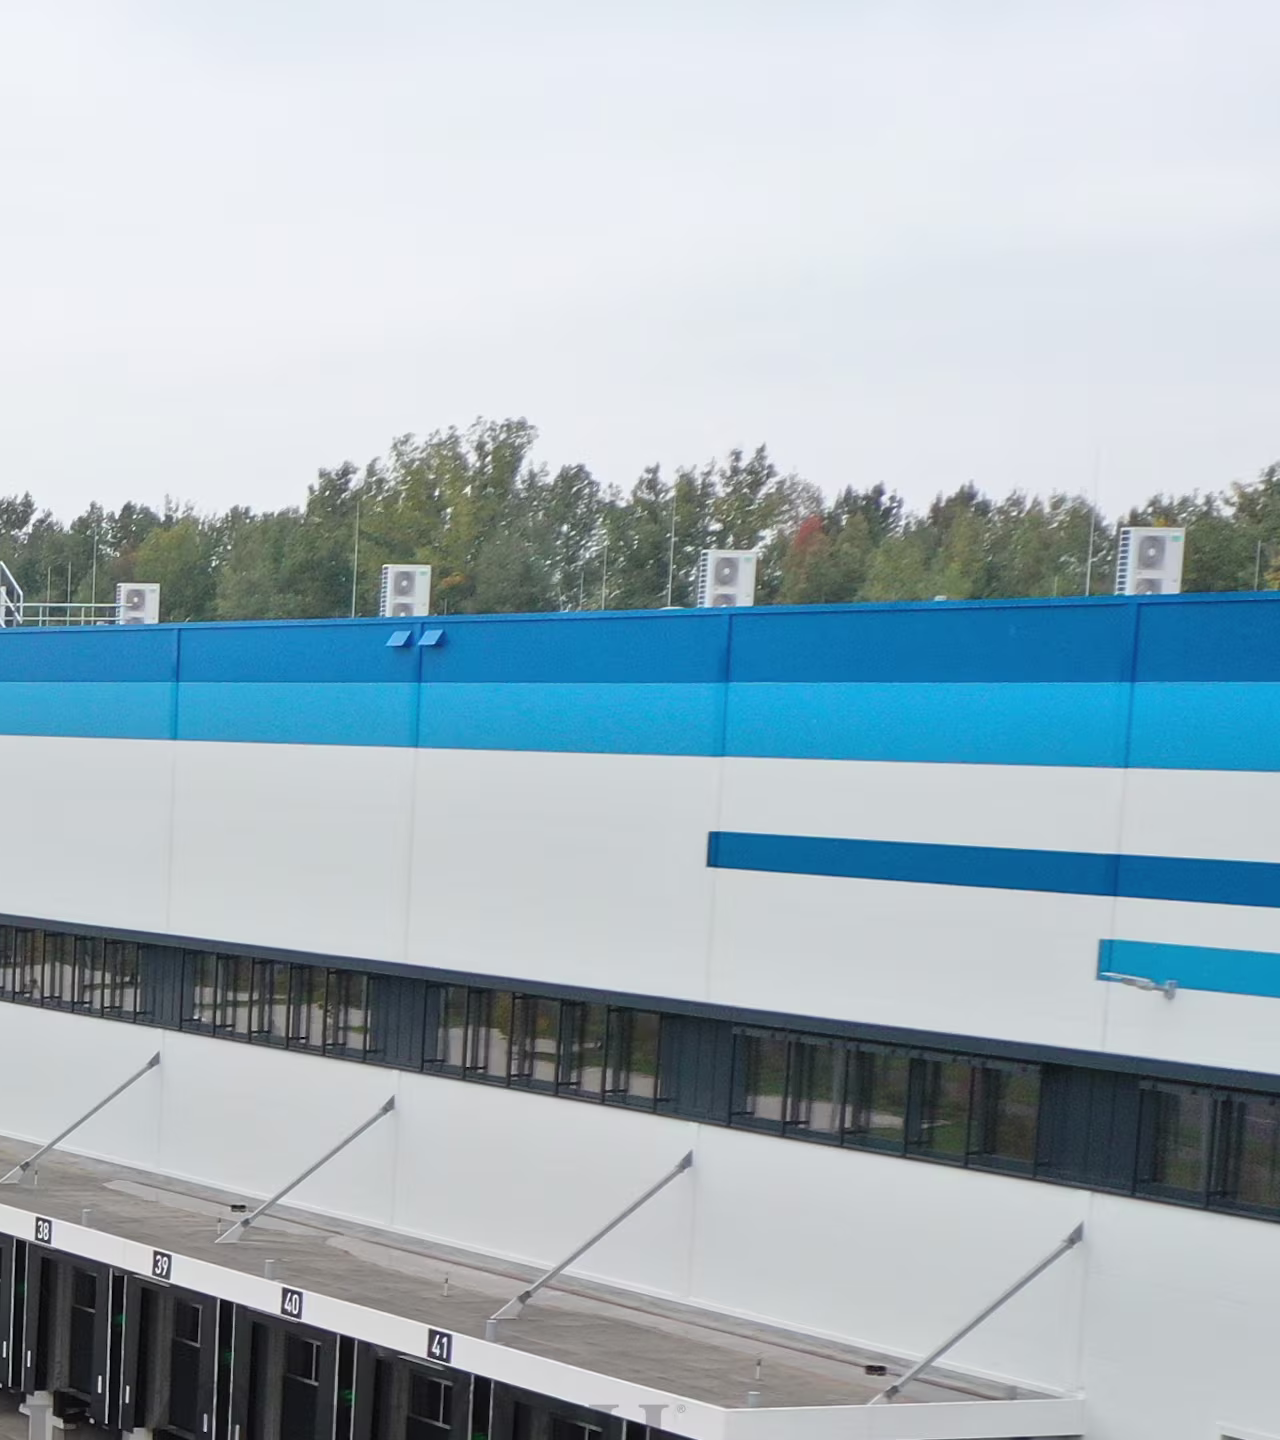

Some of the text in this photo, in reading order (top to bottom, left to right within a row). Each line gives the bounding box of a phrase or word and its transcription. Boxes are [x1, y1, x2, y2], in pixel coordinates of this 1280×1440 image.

[37, 1220, 50, 1241] 38
[154, 1254, 169, 1276] 39
[283, 1292, 300, 1315] 40
[431, 1334, 448, 1359] 41
